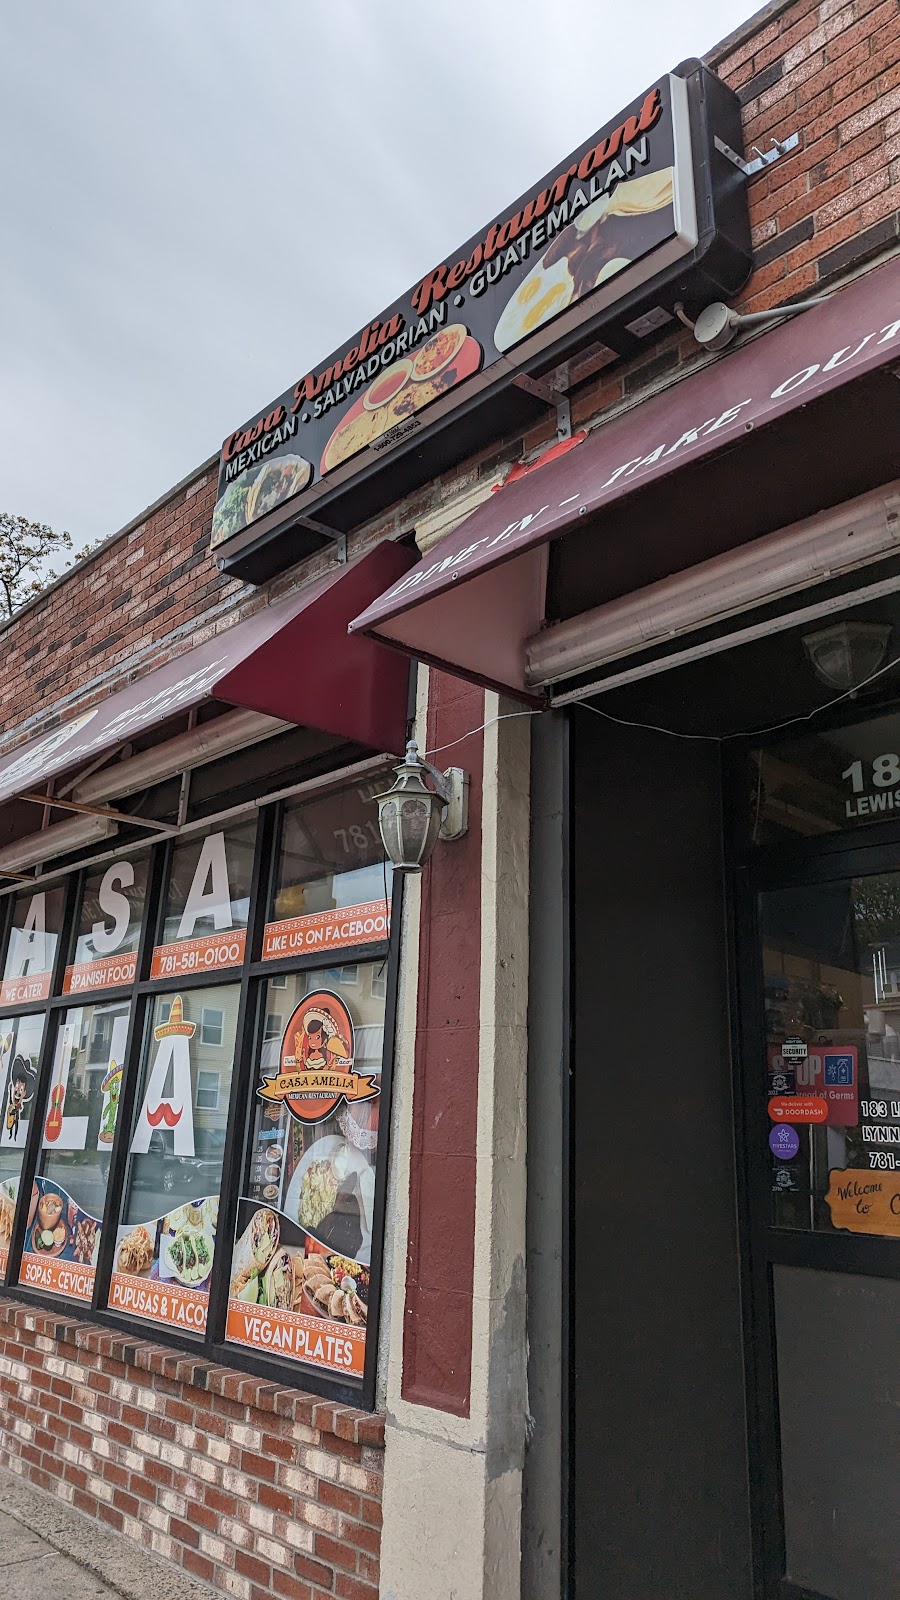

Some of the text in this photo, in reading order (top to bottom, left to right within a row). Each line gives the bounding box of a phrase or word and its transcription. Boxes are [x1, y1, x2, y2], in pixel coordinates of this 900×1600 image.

[222, 87, 662, 462] Casa Amelia Restaurant
[225, 136, 648, 481] MEXICAN SALVADORIAN GUATEMALAN
[385, 536, 489, 600] DINE
[486, 504, 549, 548] IN
[601, 398, 752, 489] TAKE
[842, 753, 900, 793] 18
[266, 934, 287, 952] LIKE
[289, 931, 303, 947] US
[305, 928, 322, 943] ON
[160, 943, 240, 973] 781-581-0100
[70, 963, 136, 990] SPANISH FOOD
[5, 983, 43, 1001] WE CATER
[280, 1076, 354, 1089] CASA AMELIA
[829, 1090, 854, 1100] Germs
[861, 1101, 887, 1117] 183
[862, 1126, 900, 1142] LYNN
[838, 1181, 883, 1200] Welcome
[854, 1199, 873, 1214] to
[26, 1263, 52, 1285] SOPAS
[113, 1285, 158, 1314] PUPUSAS
[160, 1297, 168, 1317] &
[244, 1315, 353, 1366] VEGAN PLATES
